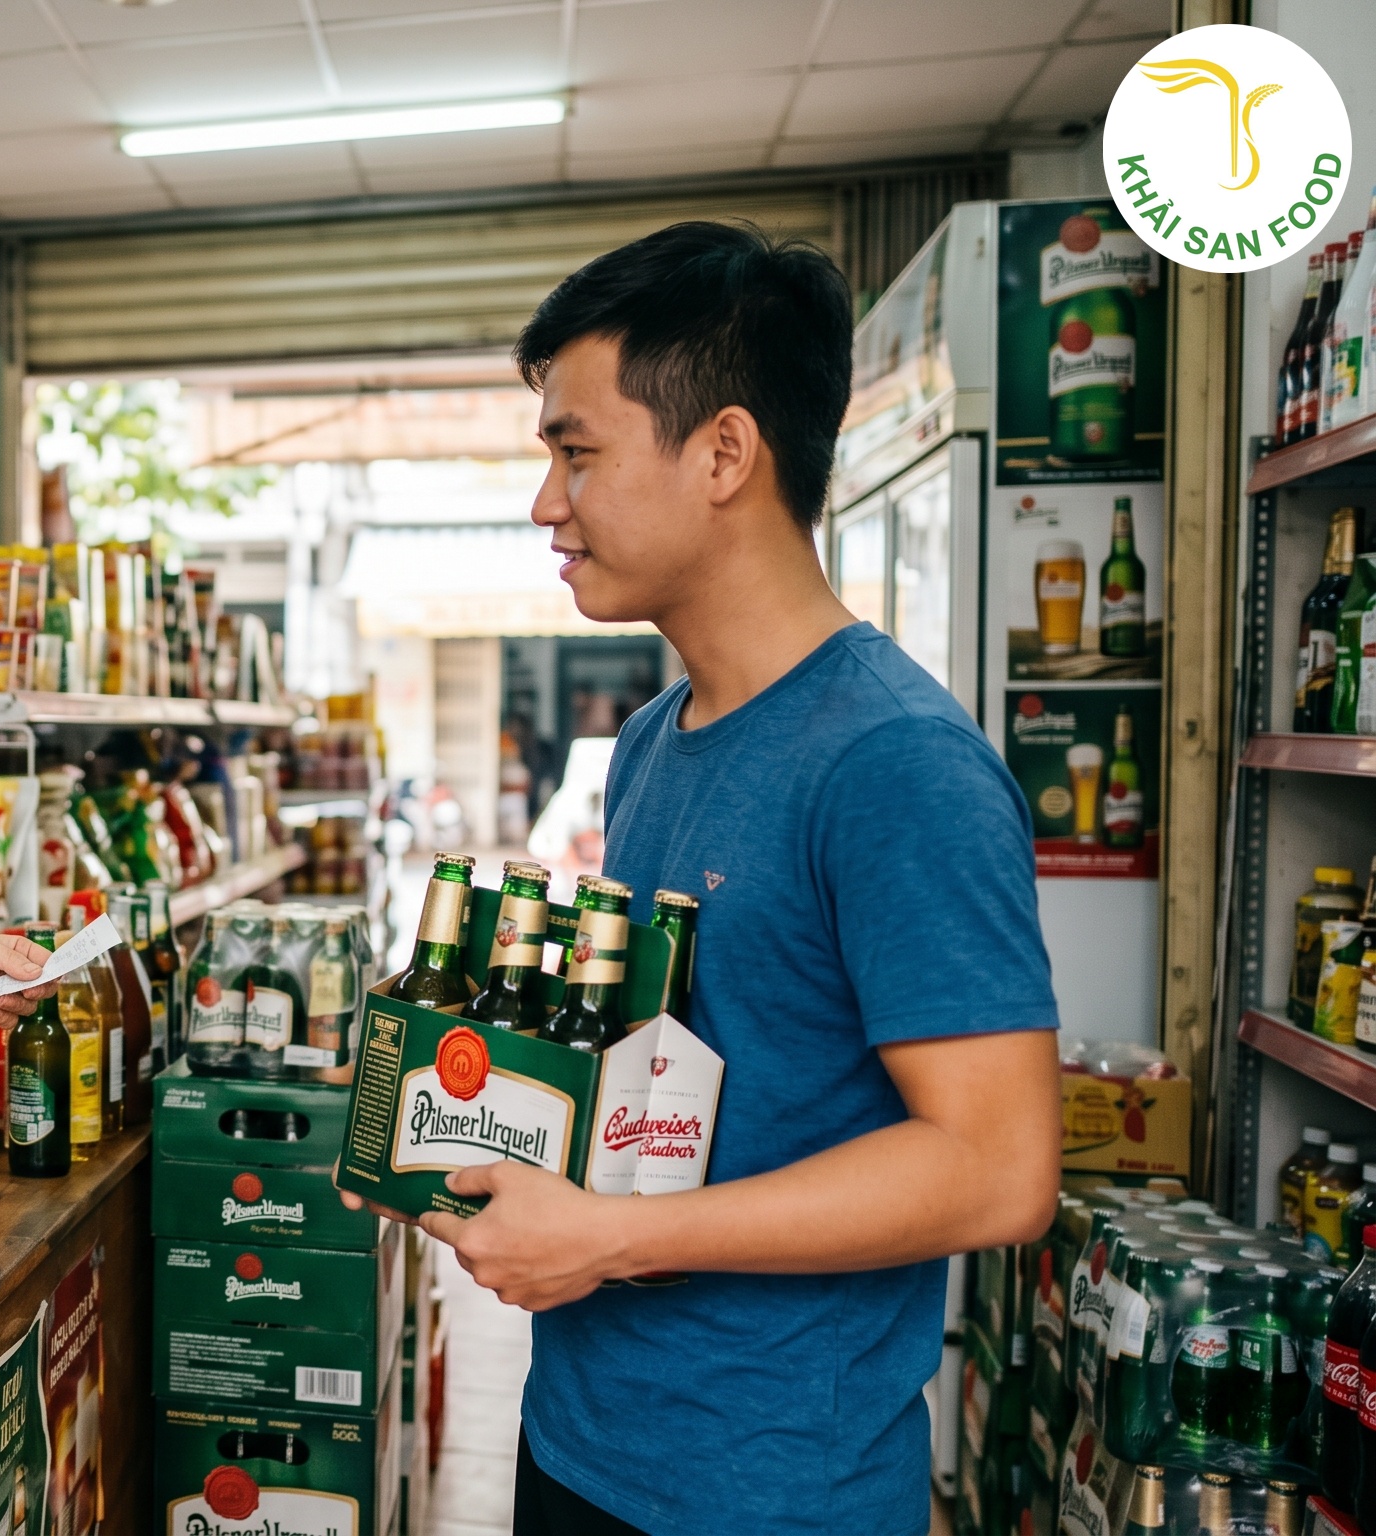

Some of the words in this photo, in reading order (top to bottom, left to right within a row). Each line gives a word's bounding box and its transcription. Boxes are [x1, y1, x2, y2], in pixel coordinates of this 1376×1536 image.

[410, 1089, 479, 1146] Pilsner
[478, 1105, 548, 1160] Urquell
[603, 1105, 702, 1144] Budweiser
[637, 1136, 697, 1159] Budvar
